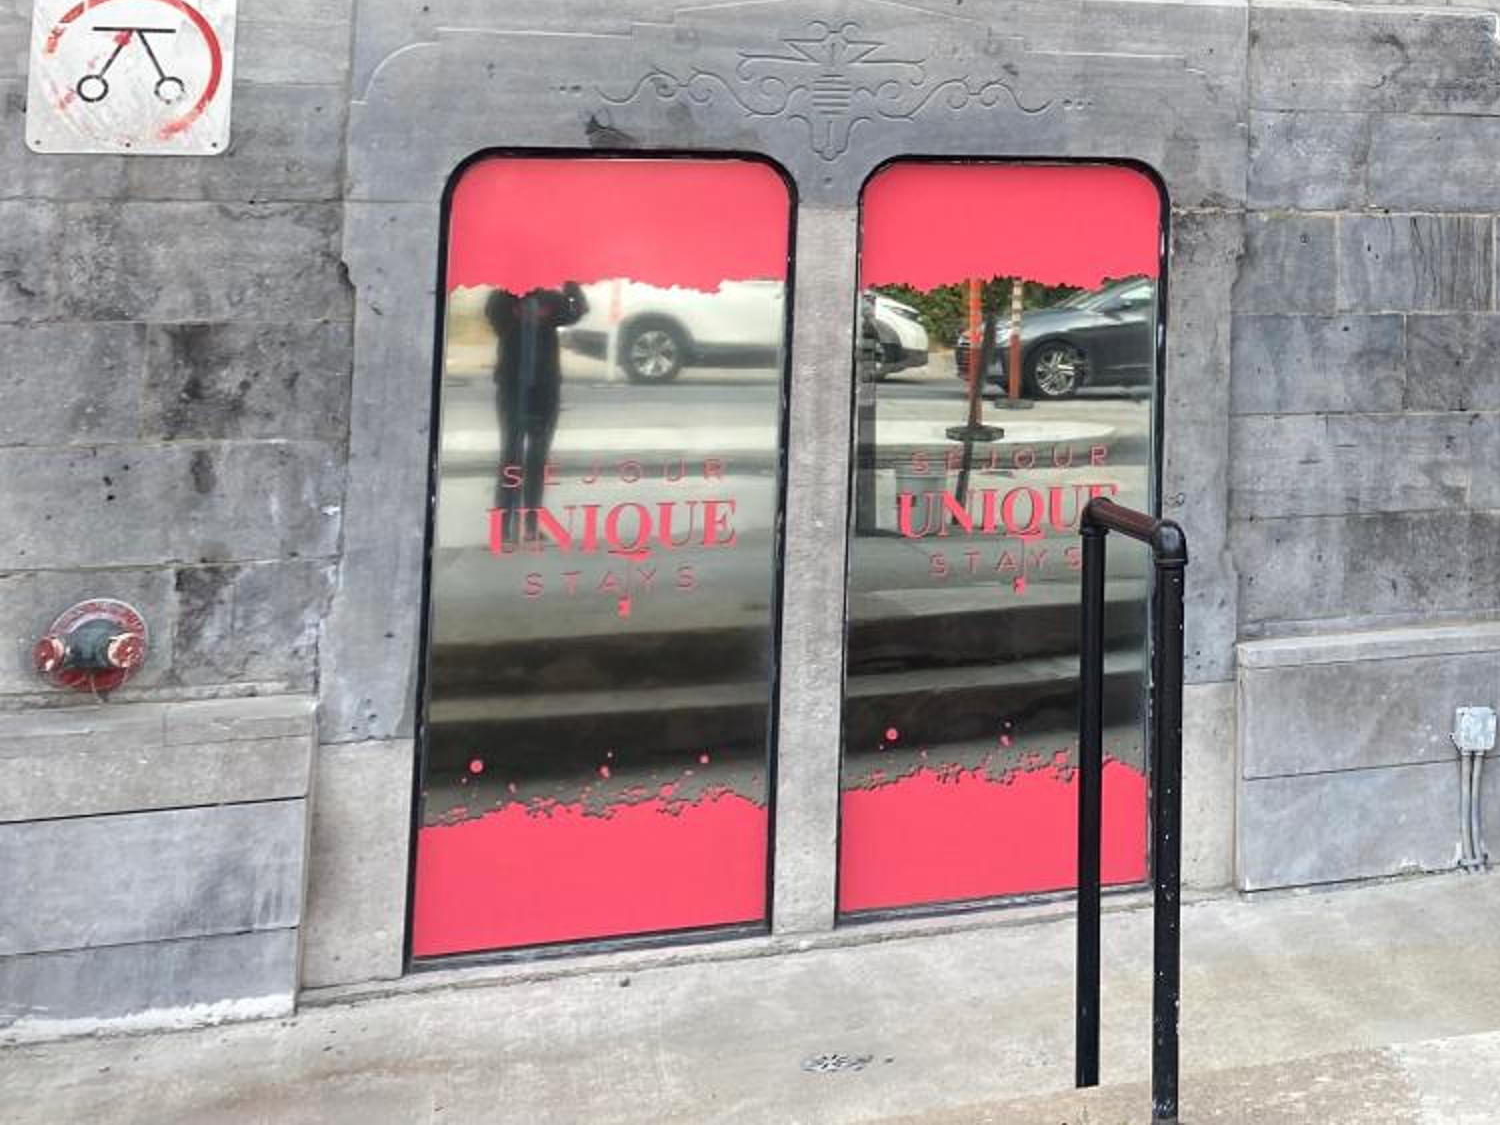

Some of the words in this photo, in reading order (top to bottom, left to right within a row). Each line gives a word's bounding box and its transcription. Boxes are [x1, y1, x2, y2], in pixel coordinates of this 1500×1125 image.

[486, 497, 737, 559] UNIQUE
[929, 546, 1082, 579] STAYS
[523, 564, 698, 599] STAYS
